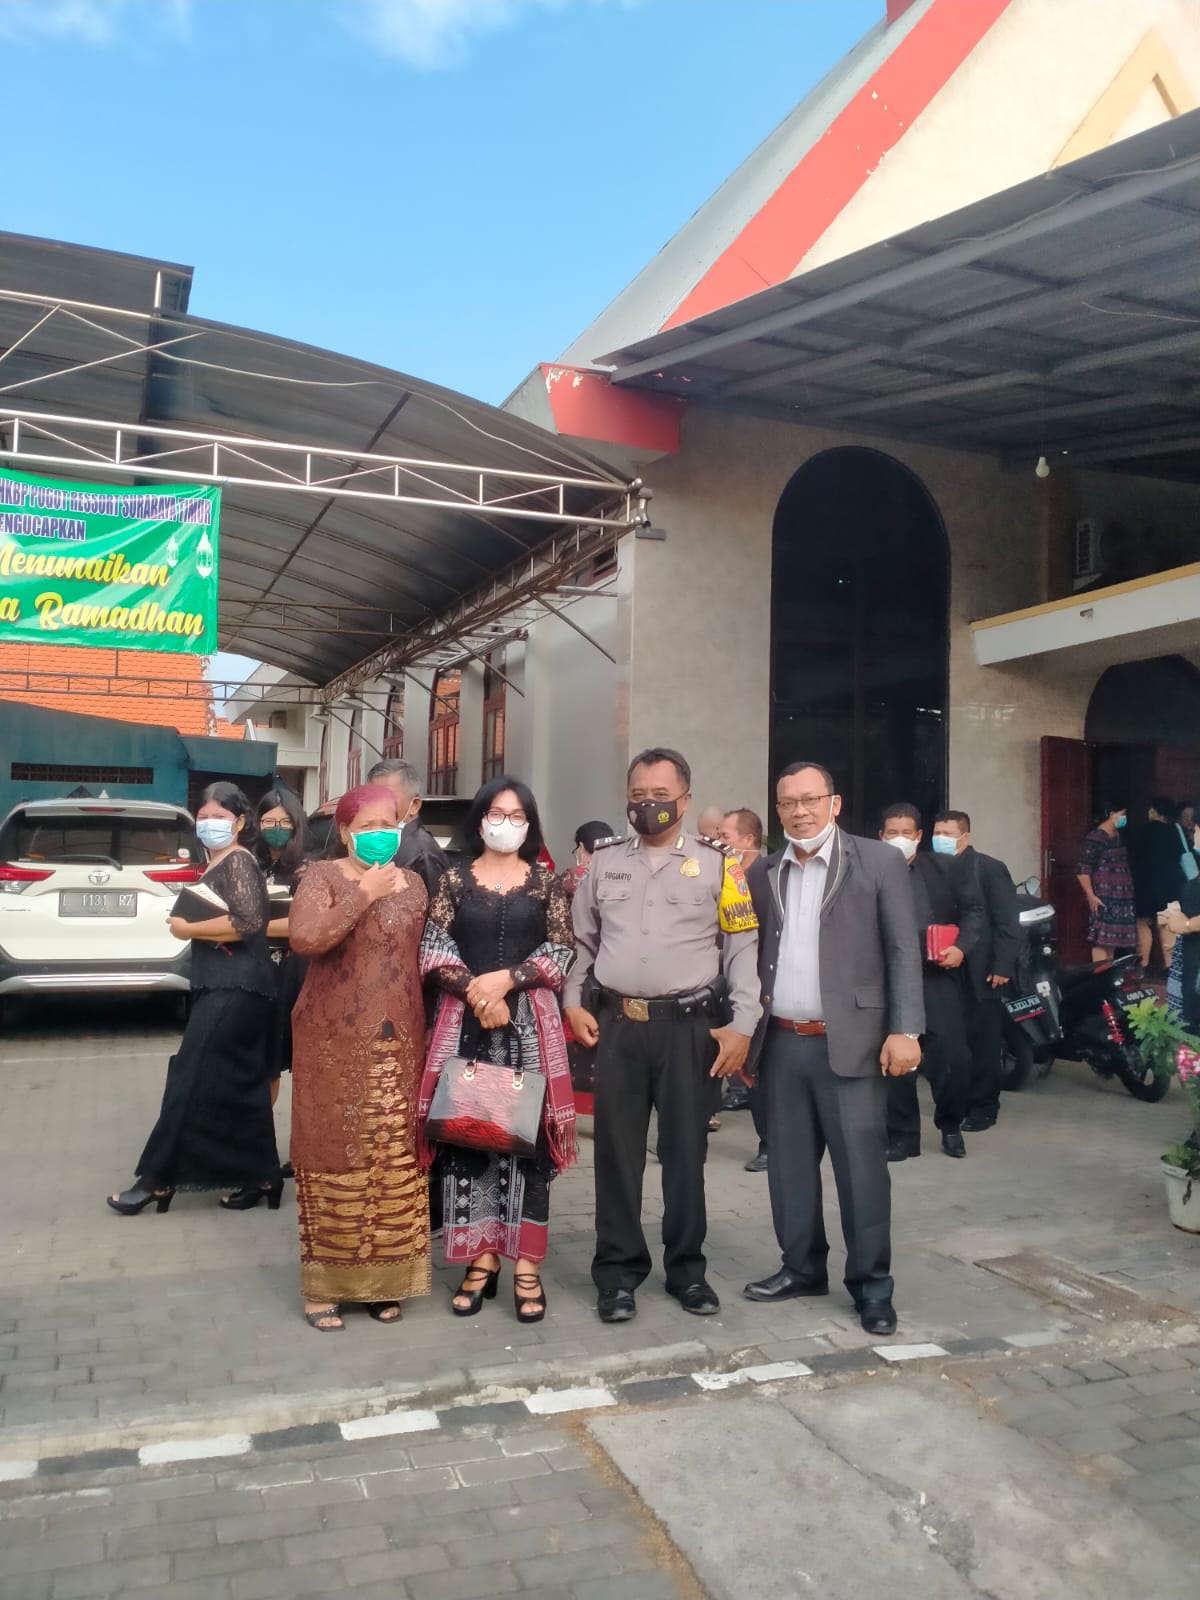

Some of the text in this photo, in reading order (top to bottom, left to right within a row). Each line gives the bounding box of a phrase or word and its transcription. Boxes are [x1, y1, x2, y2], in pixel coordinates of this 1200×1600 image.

[69, 489, 120, 517] RESSORT
[122, 495, 176, 521] SURABAYA
[178, 498, 212, 525] TIMUR
[35, 592, 205, 636] Ramadhan
